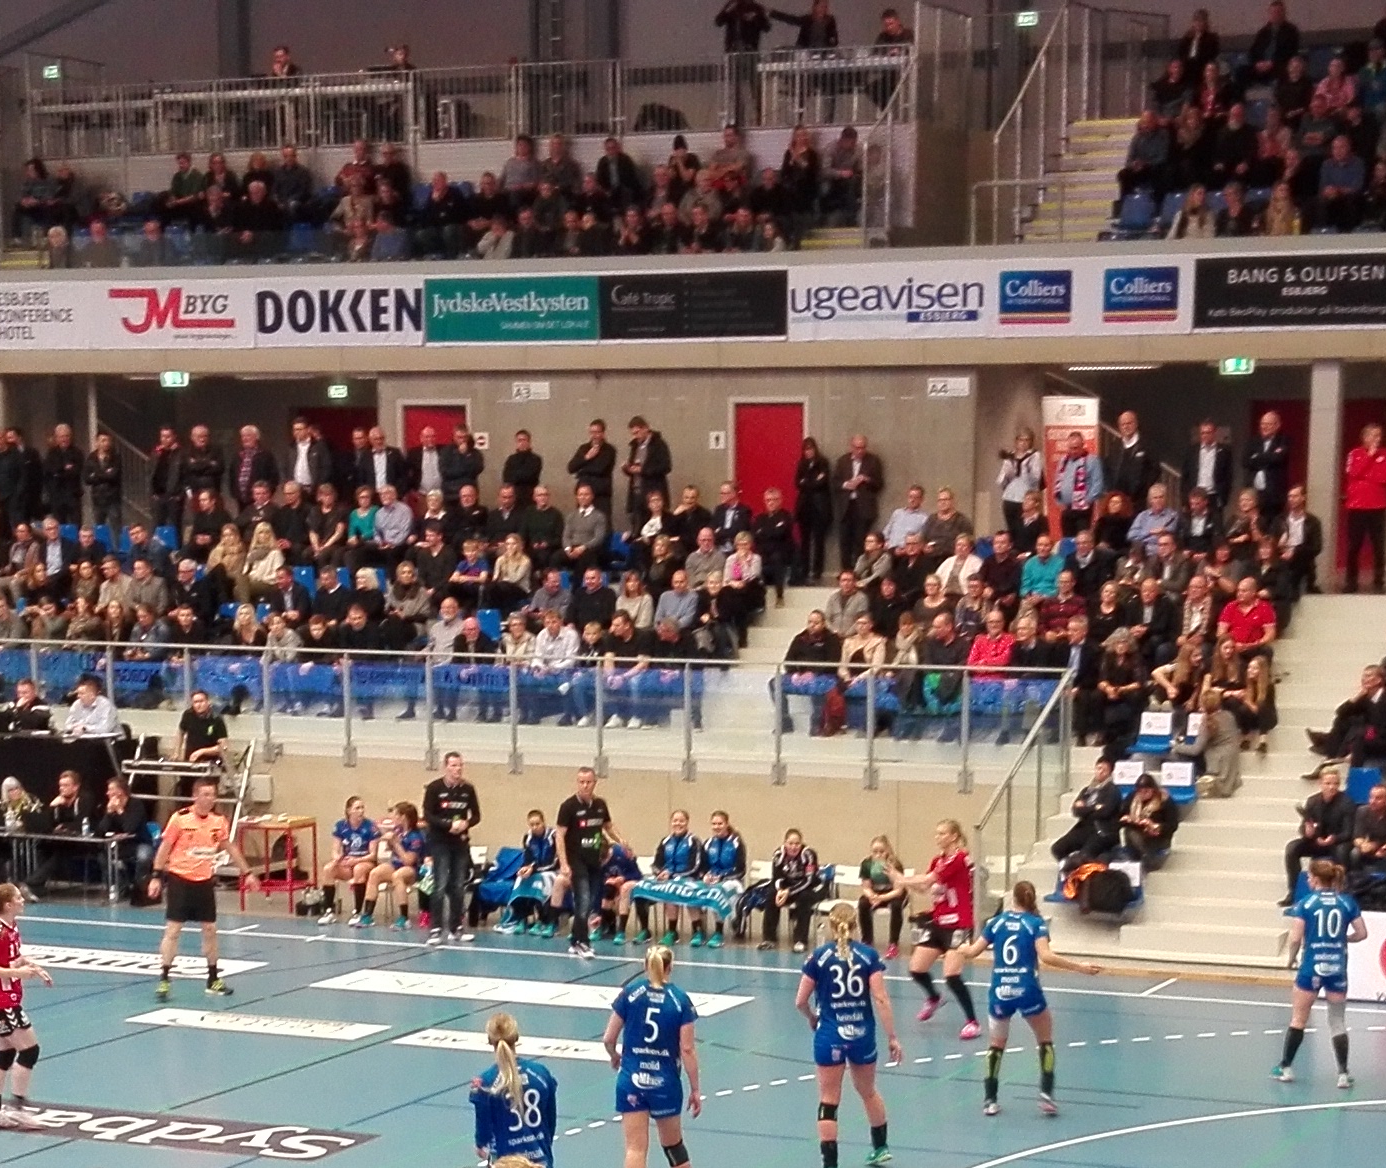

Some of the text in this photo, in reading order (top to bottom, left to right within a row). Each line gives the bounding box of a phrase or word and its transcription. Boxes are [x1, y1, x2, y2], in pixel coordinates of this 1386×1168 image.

[1005, 279, 1067, 297] Colliers
[1110, 277, 1173, 295] Colliers
[1227, 265, 1386, 284] BANG & OLUFSEN
[183, 295, 229, 315] BYG
[790, 277, 986, 320] ugeavisen
[1313, 909, 1342, 938] 10
[1003, 935, 1018, 965] 6
[829, 964, 864, 999] 36
[644, 1007, 660, 1043] 5
